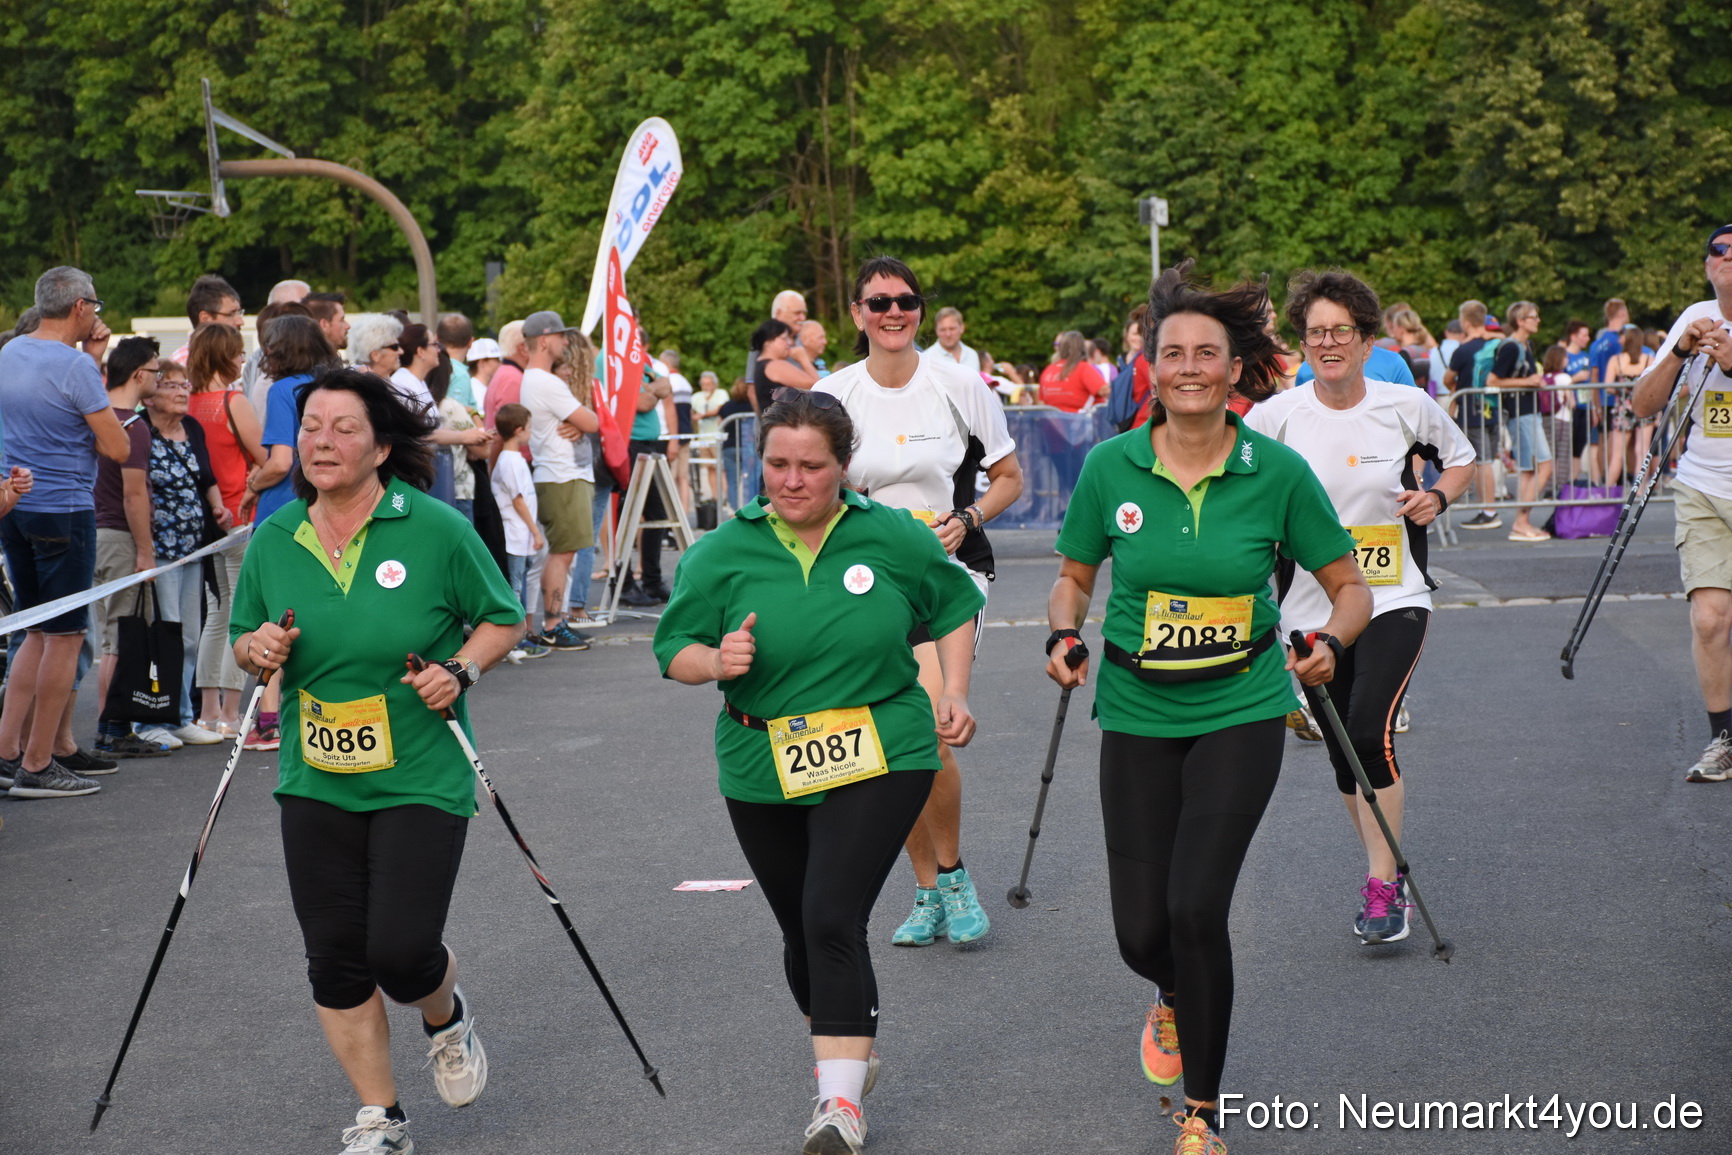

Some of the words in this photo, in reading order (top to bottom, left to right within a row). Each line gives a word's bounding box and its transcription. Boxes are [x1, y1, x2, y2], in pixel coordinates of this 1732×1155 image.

[1709, 407, 1732, 424] 23
[1240, 440, 1253, 467] AOK
[391, 492, 405, 513] AOK
[1161, 609, 1204, 621] firmenlauf
[1228, 616, 1245, 624] 2019
[1157, 623, 1237, 650] 2083
[362, 717, 381, 726] 2019
[849, 719, 867, 729] 2019
[306, 721, 377, 754] 2086
[784, 723, 824, 740] firmenlauf
[322, 753, 341, 762] Spitz
[342, 754, 356, 762] Uta
[785, 728, 862, 774] 2087
[335, 760, 371, 768] Kindergarten
[806, 768, 829, 779] Waas
[830, 761, 857, 773] Nicole
[802, 777, 829, 787] Rot-Kreuz
[829, 767, 865, 780] Kindergarten
